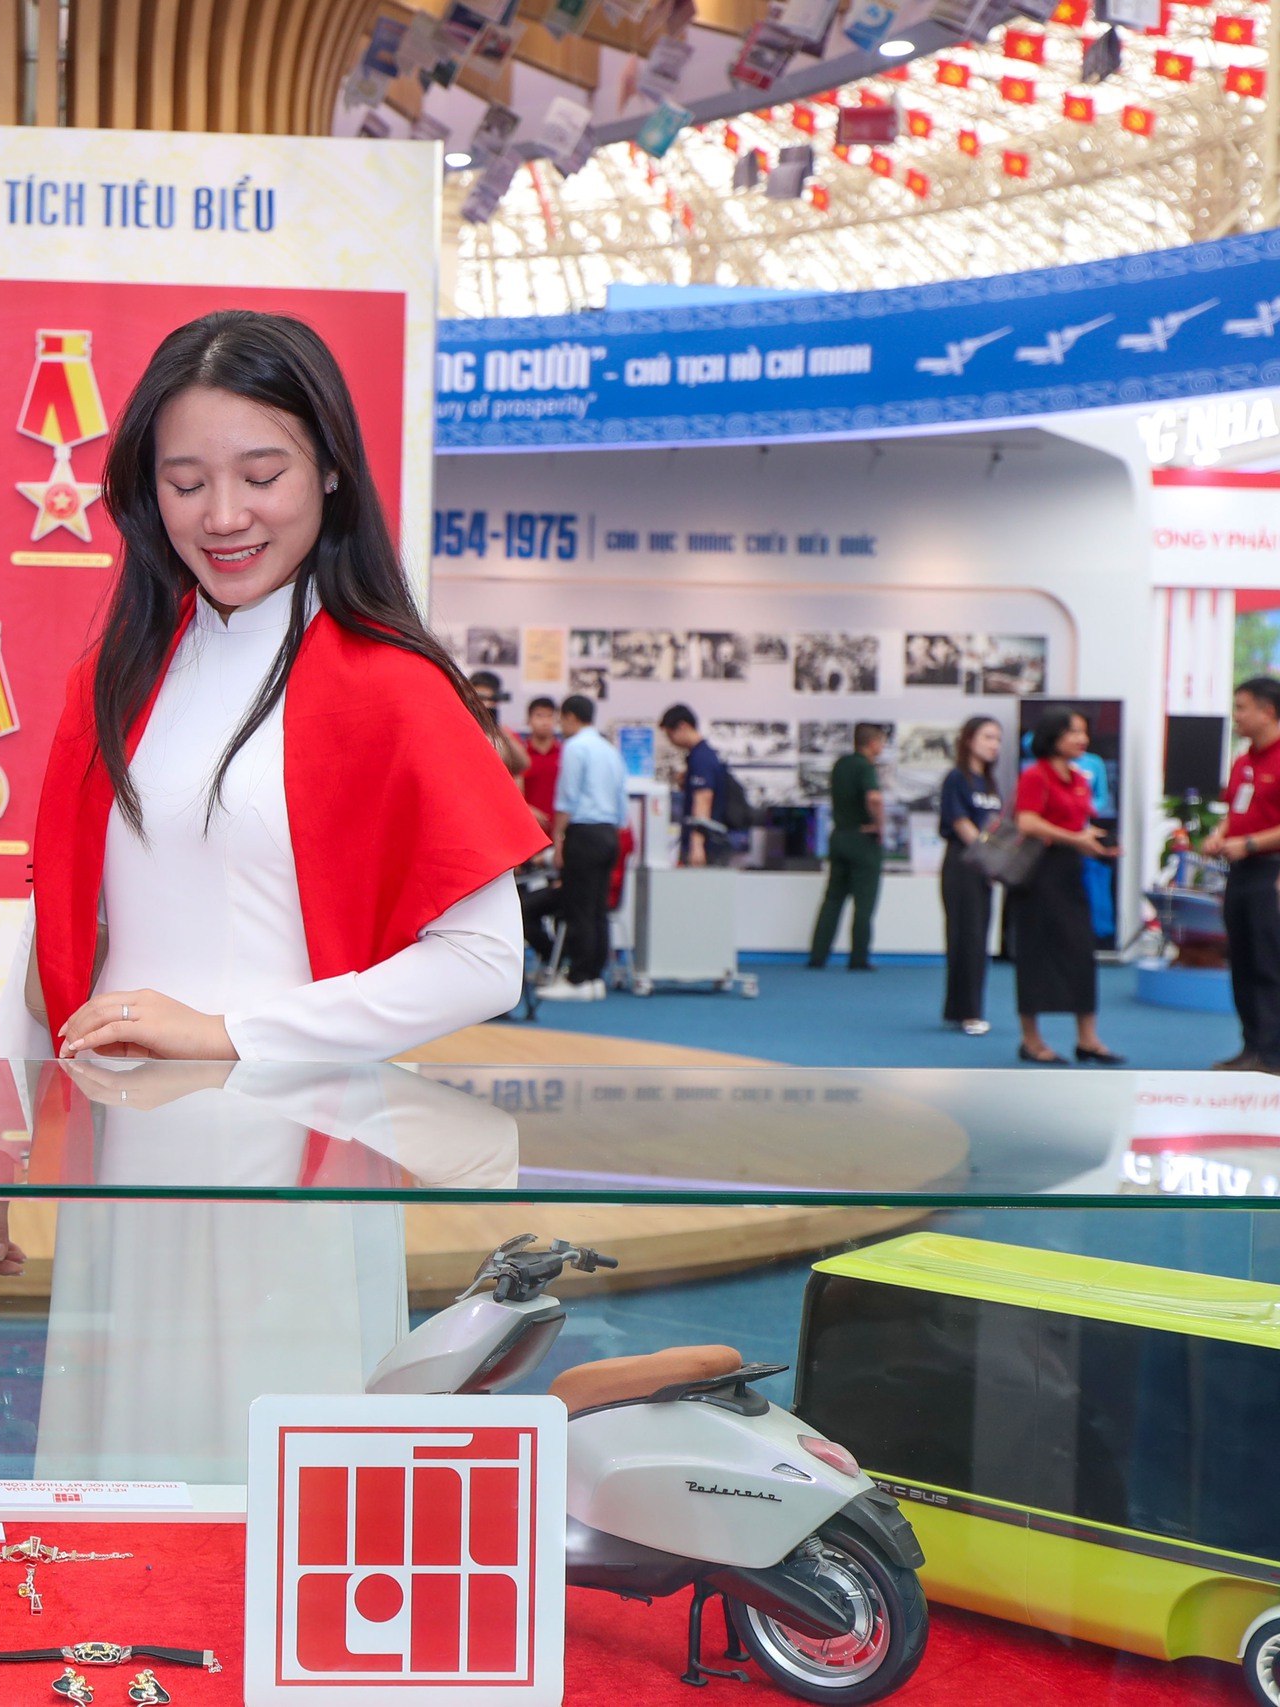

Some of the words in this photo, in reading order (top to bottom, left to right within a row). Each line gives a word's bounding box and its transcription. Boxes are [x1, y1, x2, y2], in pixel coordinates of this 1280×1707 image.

[5, 174, 85, 226] TÍCH
[100, 178, 175, 229] TIÊU
[193, 175, 276, 232] BIỂU
[624, 352, 671, 387] CHỦ
[676, 354, 726, 388] TỊCH
[728, 345, 762, 382] HỒ
[467, 393, 490, 418] of
[909, 1488, 949, 1505] BUS
